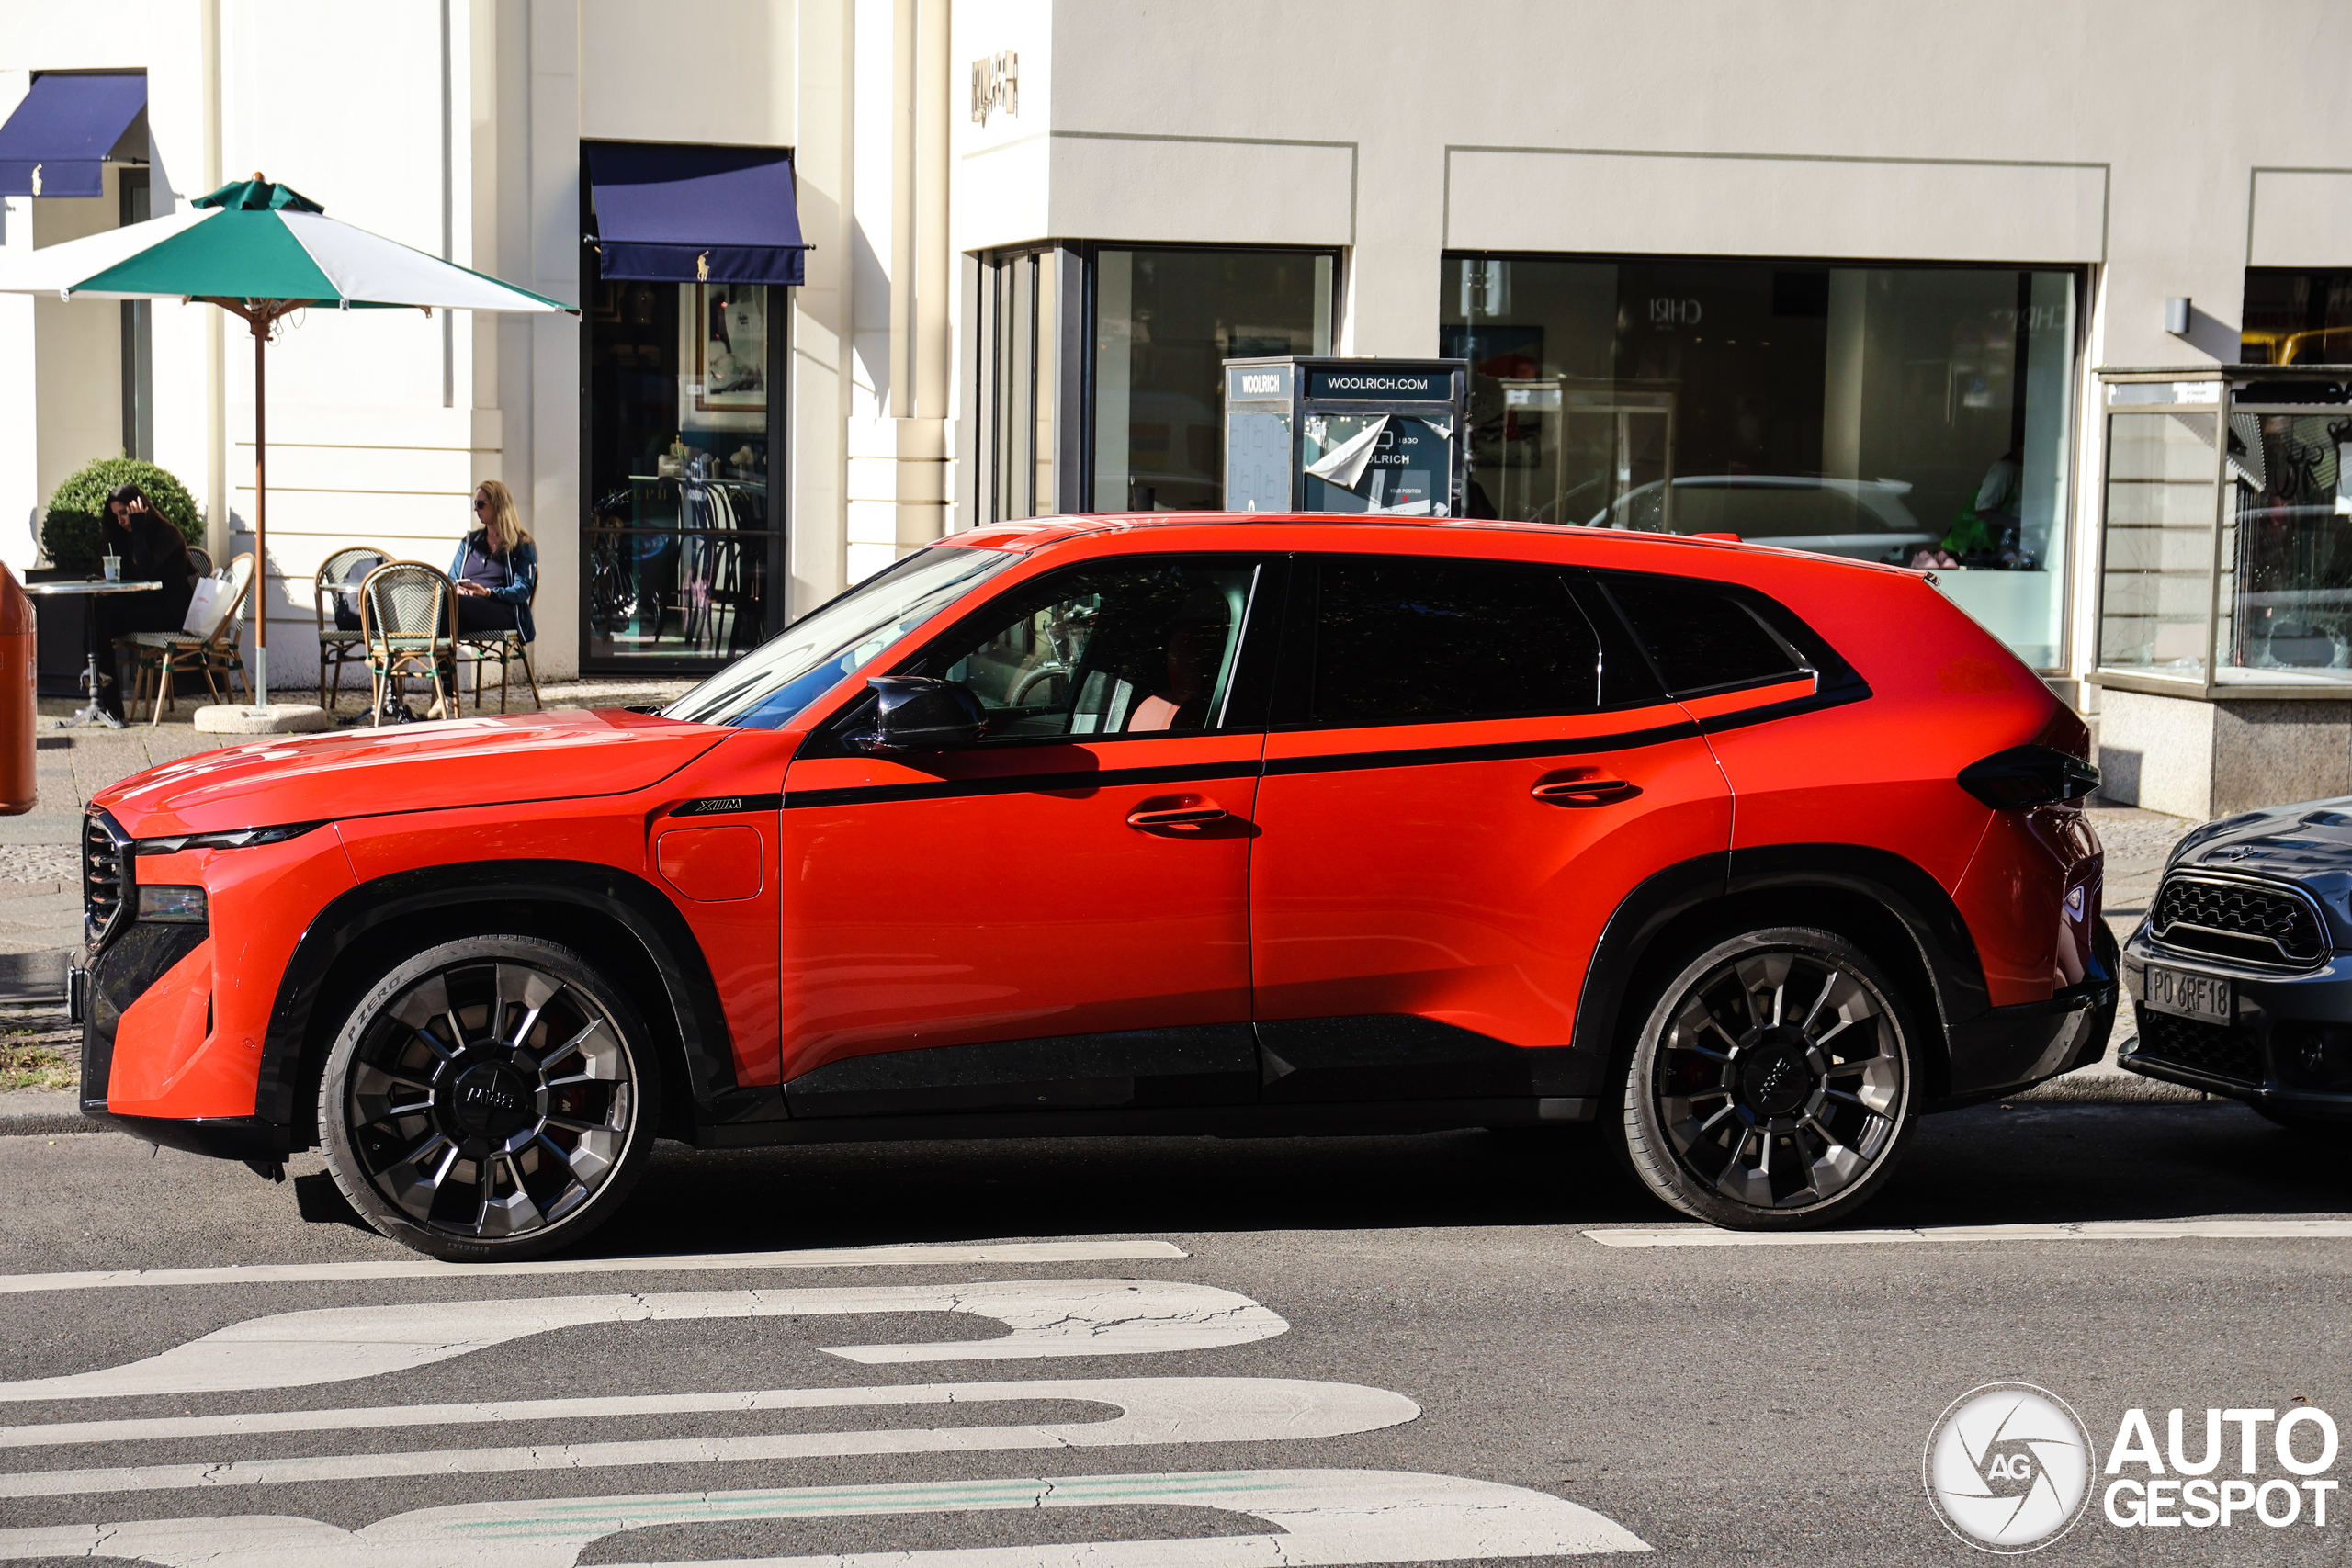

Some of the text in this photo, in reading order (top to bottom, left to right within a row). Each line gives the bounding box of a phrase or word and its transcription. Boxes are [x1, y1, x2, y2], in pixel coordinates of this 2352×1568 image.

[1242, 374, 1280, 394] WOOLRICH
[1328, 378, 1429, 390] WOOLRICH.COM
[2154, 968, 2227, 1016] PO 6RF18
[347, 976, 401, 1043] P ZERO
